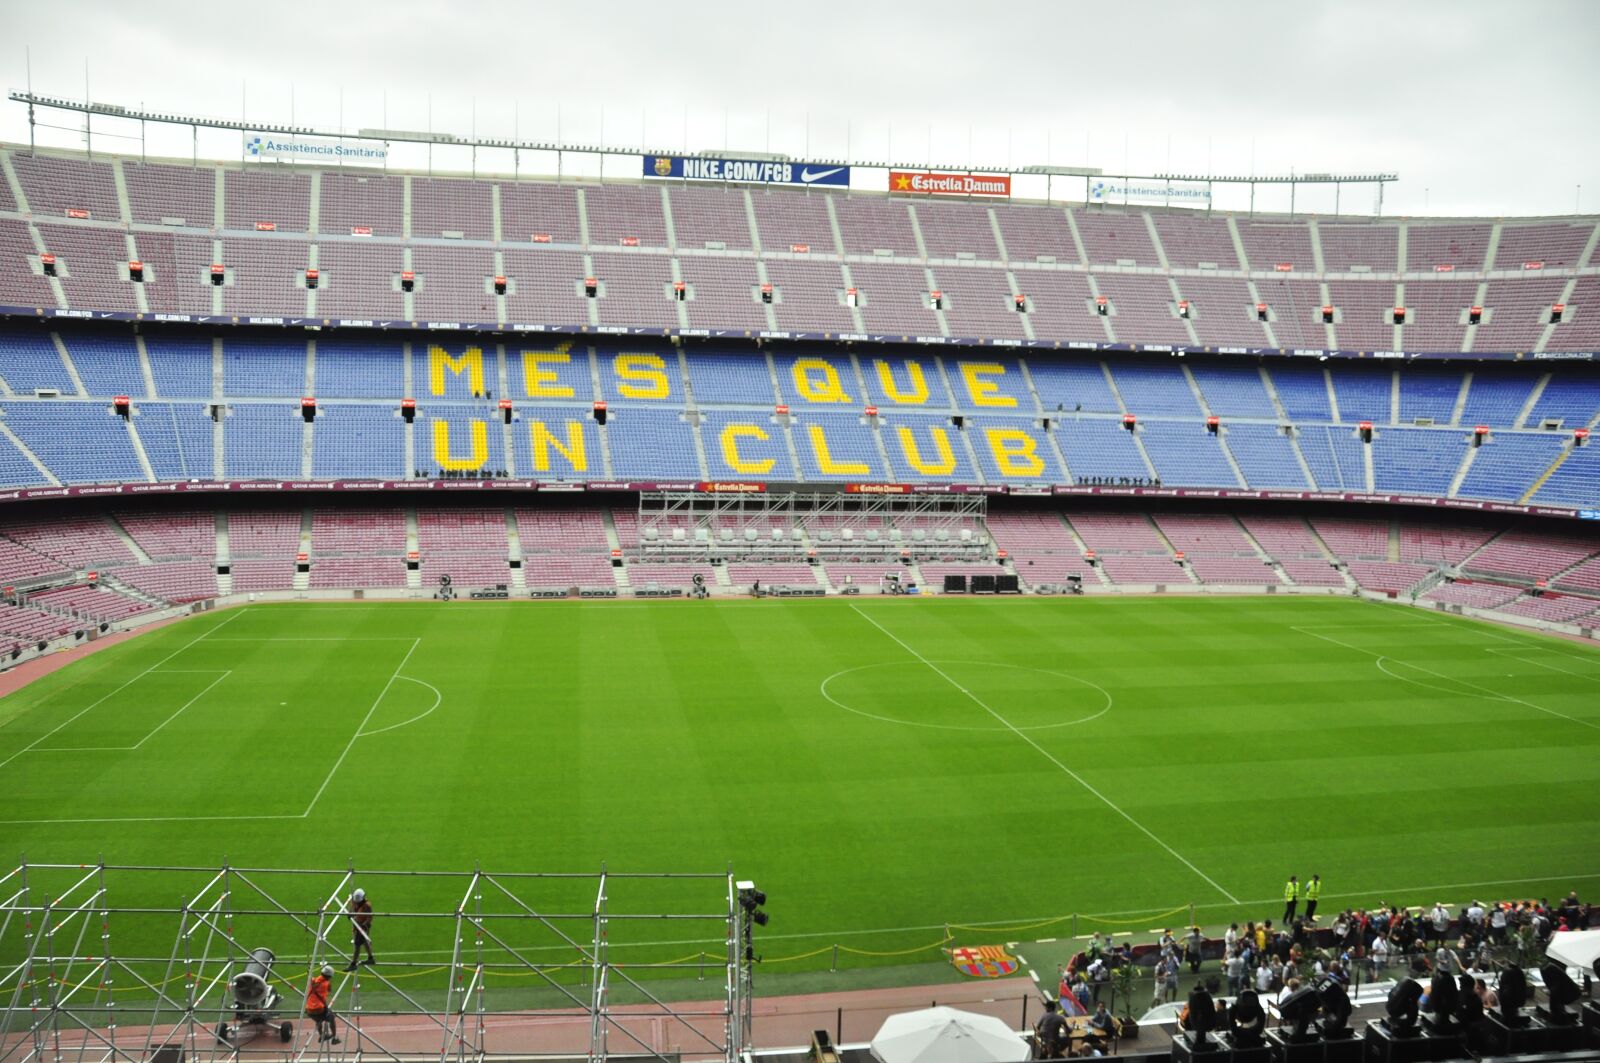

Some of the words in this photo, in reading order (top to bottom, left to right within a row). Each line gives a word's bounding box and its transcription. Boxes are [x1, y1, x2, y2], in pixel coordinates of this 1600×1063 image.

[266, 140, 333, 155] Assistència
[683, 159, 792, 182] NIKE.COM/FCB
[911, 175, 962, 191] Estrella
[963, 177, 1006, 193] Damm
[428, 341, 670, 399] MÉS
[791, 357, 1018, 408] QUE
[431, 417, 588, 472] UN
[719, 423, 1045, 477] CLUB
[714, 483, 738, 491] Estrella
